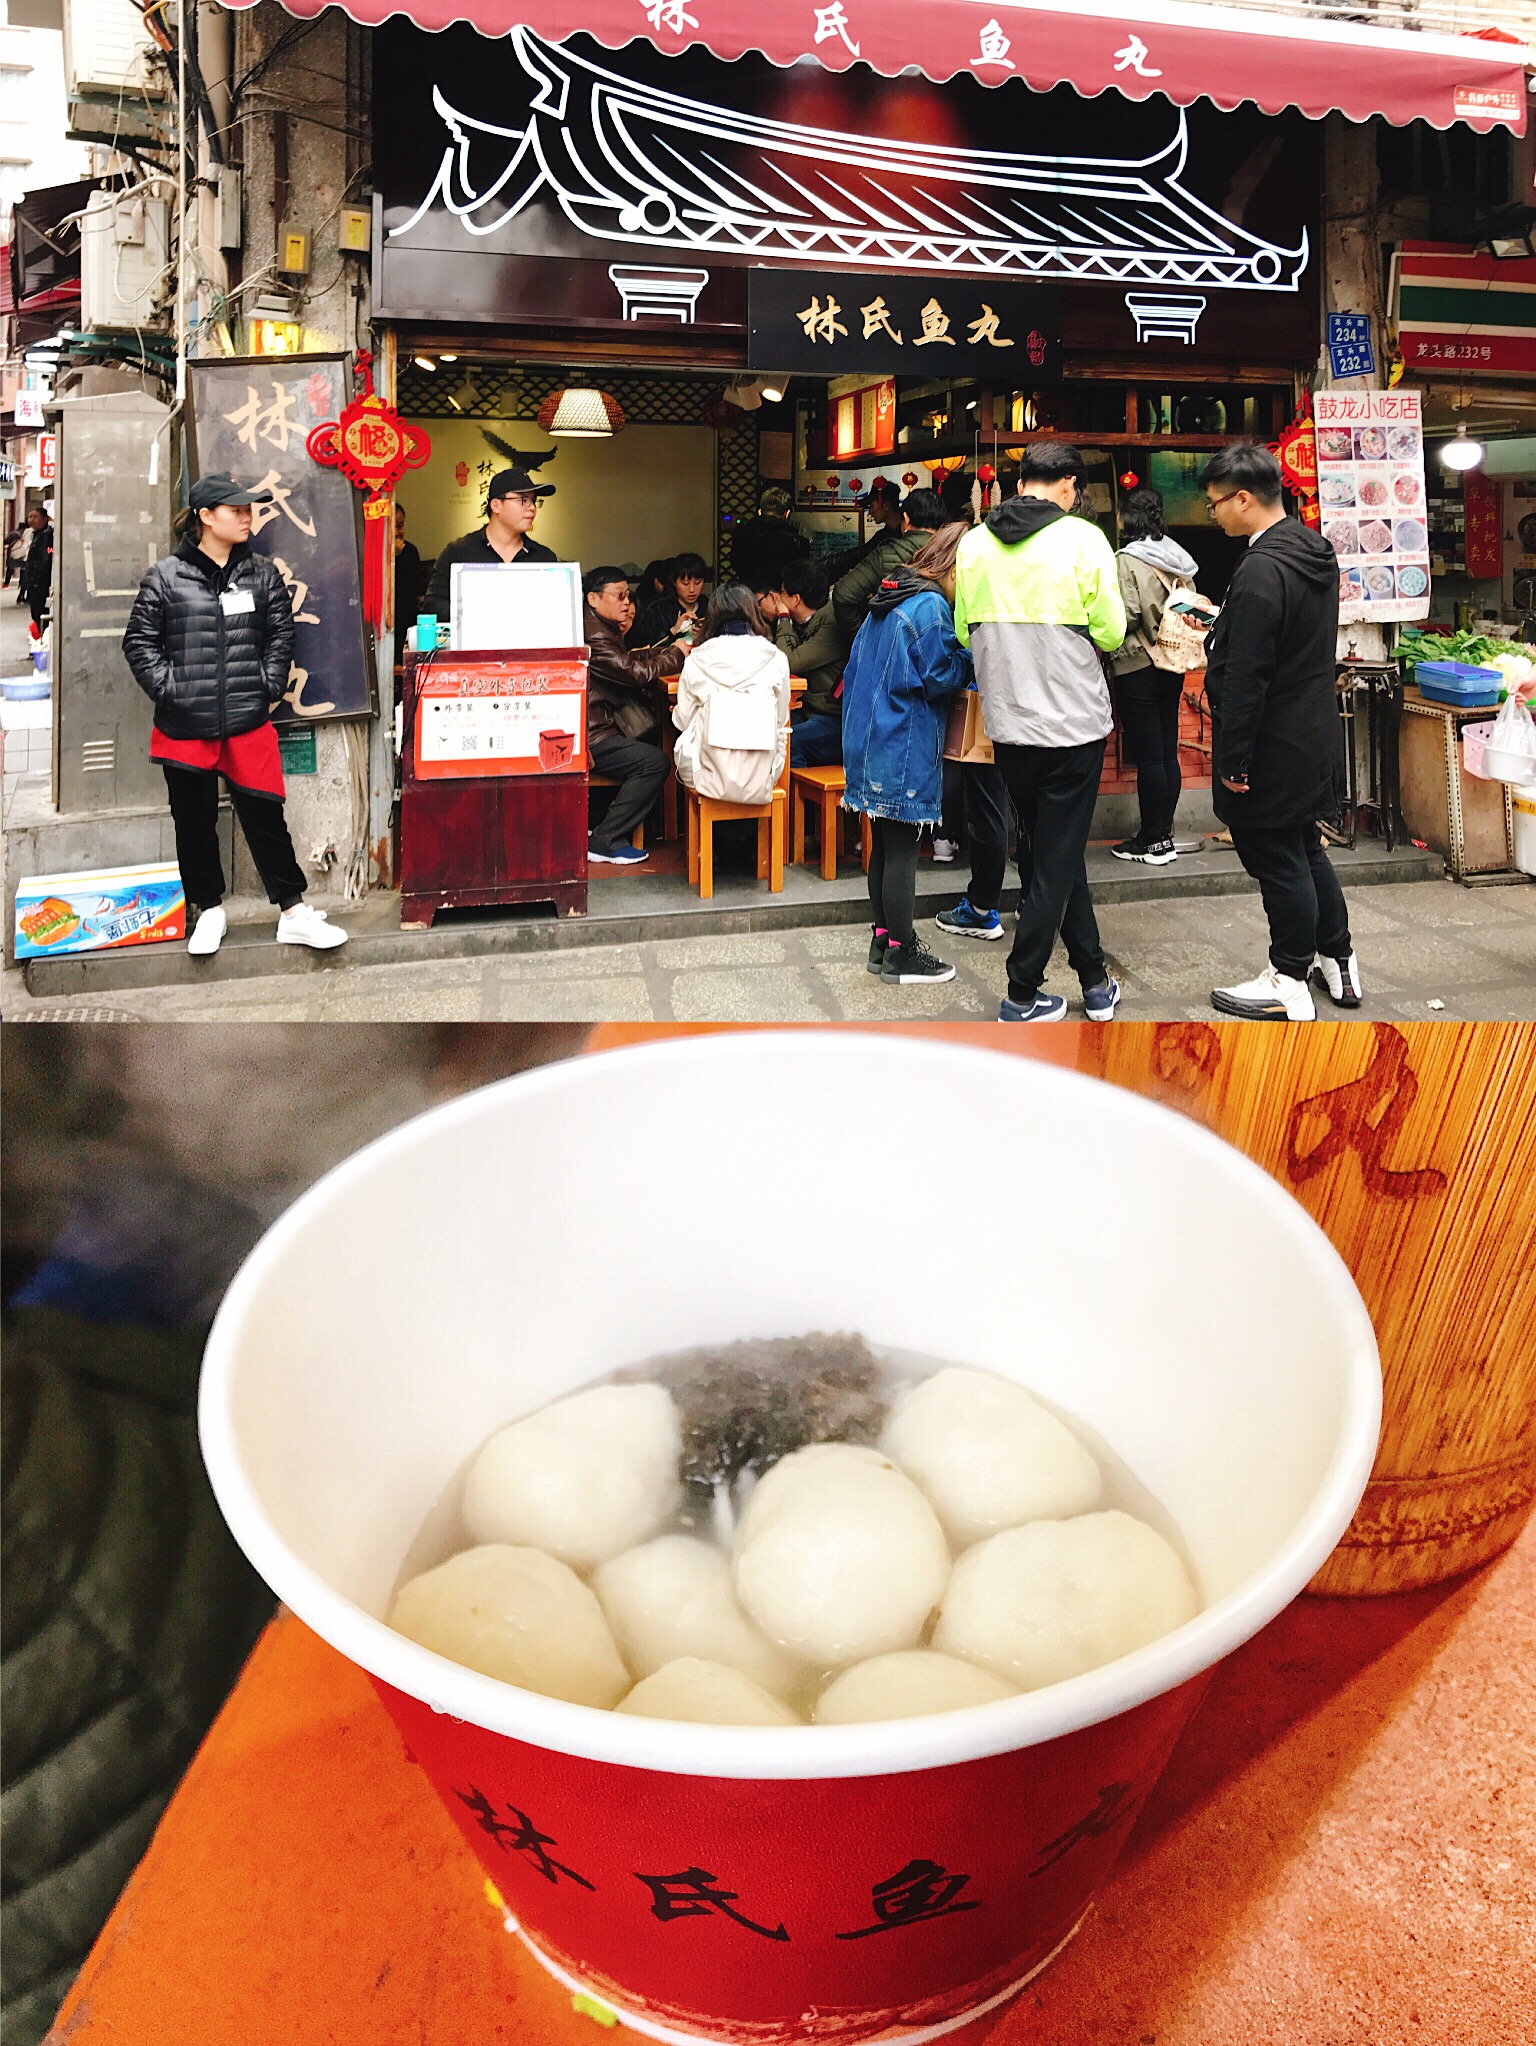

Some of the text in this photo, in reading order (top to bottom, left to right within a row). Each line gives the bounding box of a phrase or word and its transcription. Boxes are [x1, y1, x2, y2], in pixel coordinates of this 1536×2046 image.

[645, 0, 1163, 77] 林氏鱼丸
[796, 294, 1015, 347] 林氏鱼丸
[1335, 328, 1357, 342] 234
[1416, 342, 1492, 360] 龙头路232号
[1340, 355, 1362, 373] 232
[1318, 396, 1419, 419] 鼓龙小吃店
[358, 423, 388, 458] 福
